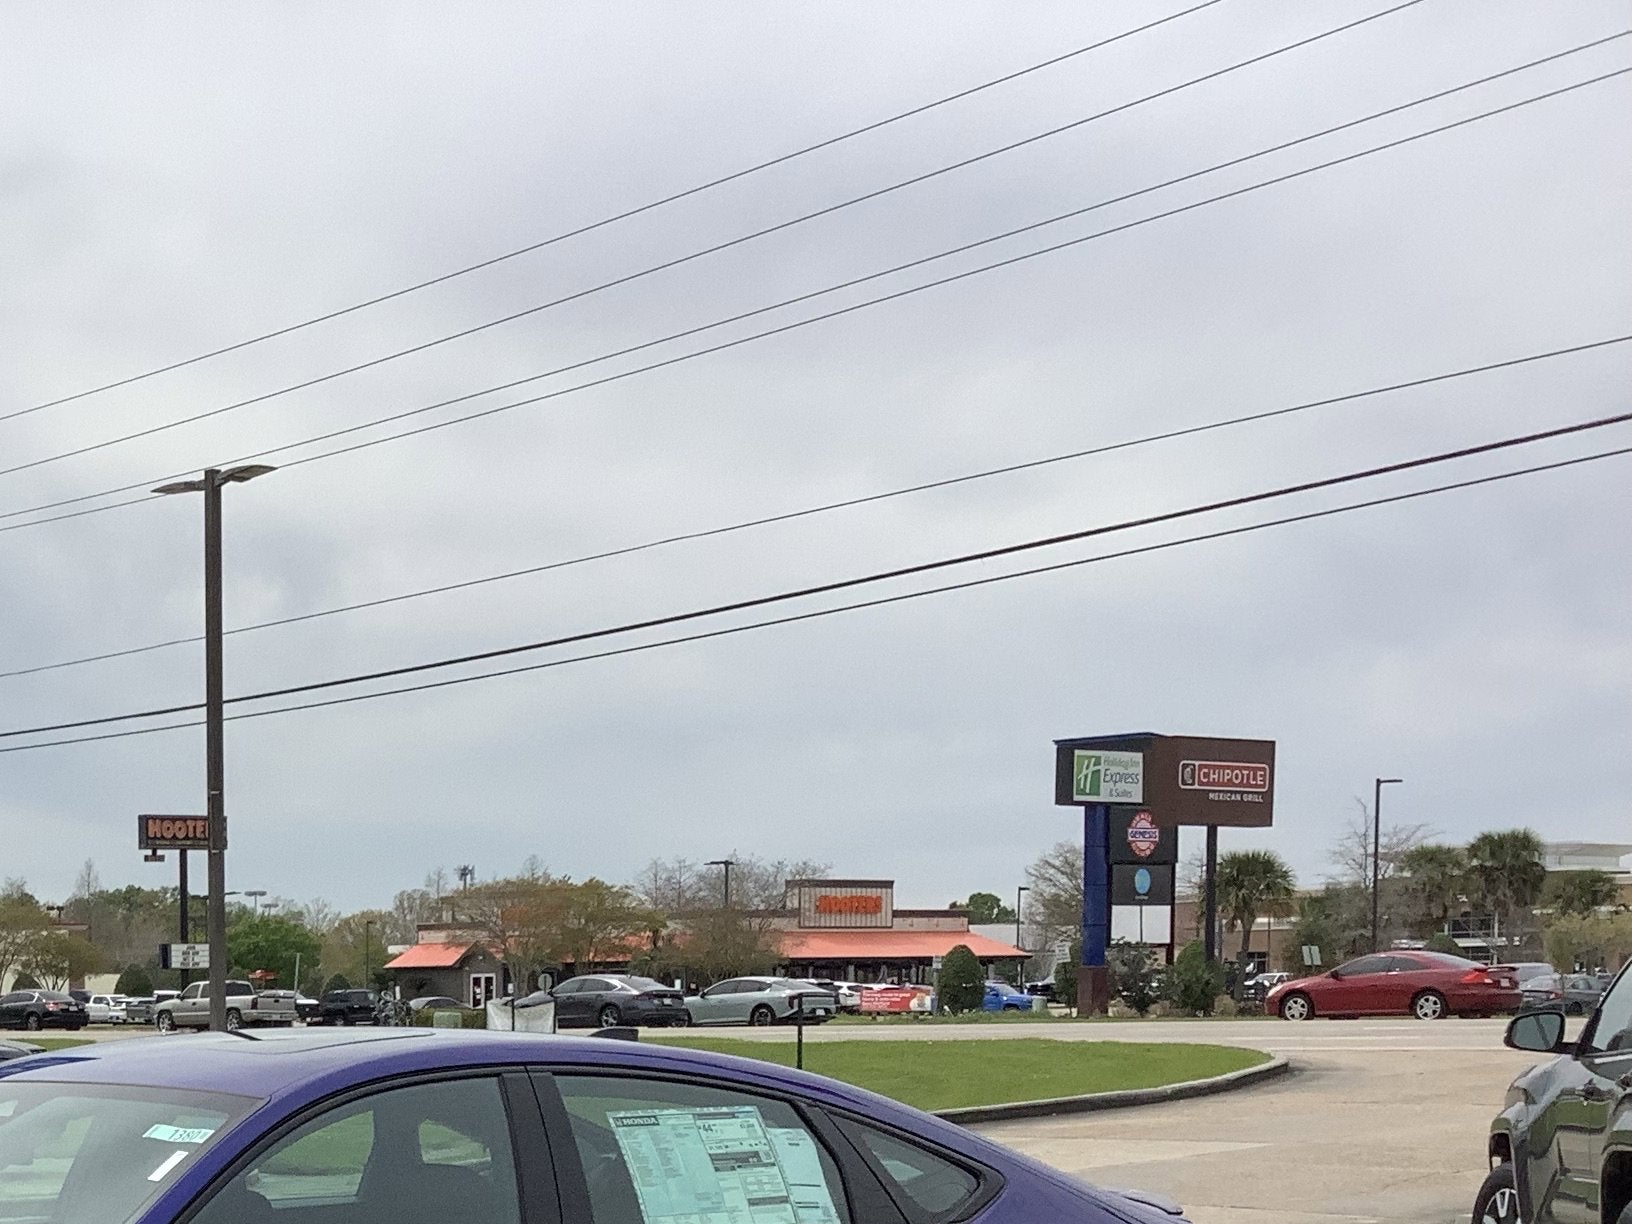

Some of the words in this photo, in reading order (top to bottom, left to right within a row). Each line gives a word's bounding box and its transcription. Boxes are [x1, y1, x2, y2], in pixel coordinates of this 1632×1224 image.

[1103, 768, 1140, 787] Express
[1200, 768, 1265, 785] CHIPOTLE
[1208, 792, 1241, 801] MEXICAN
[148, 819, 209, 839] HOOTE
[623, 1117, 658, 1126] HONDA
